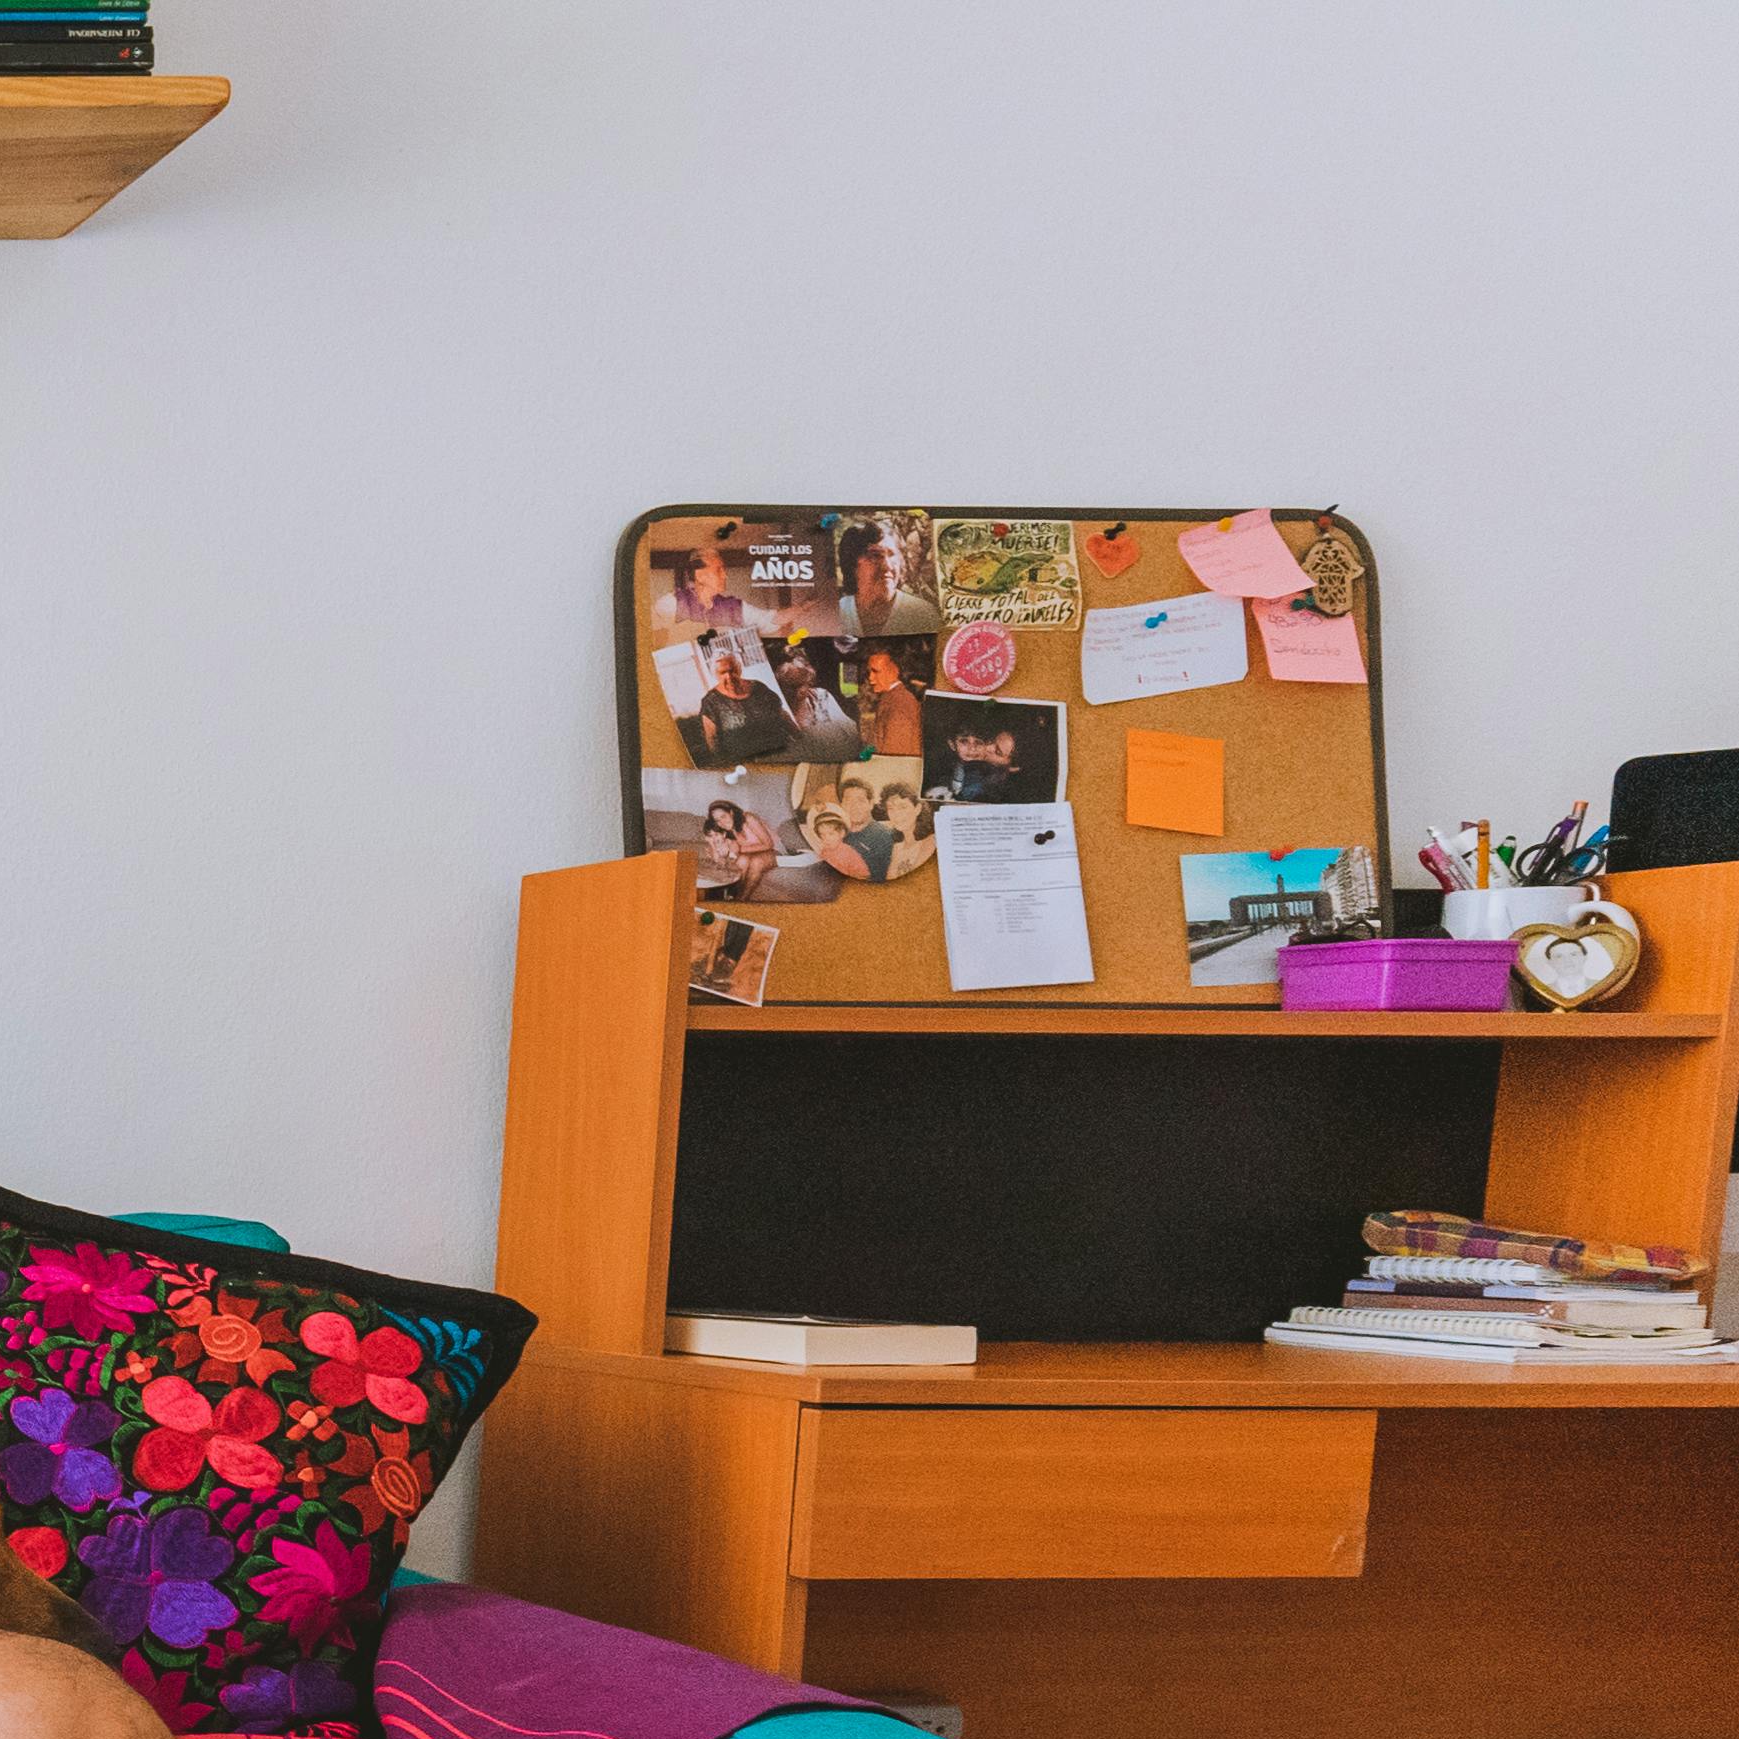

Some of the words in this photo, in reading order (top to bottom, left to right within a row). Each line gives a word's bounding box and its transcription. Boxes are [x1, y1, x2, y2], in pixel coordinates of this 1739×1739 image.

[68, 29, 123, 37] INTERNATIONAL
[749, 545, 789, 555] CUIDAR
[792, 545, 813, 555] LOS
[751, 556, 814, 580] AÑOS
[990, 590, 1031, 608] TOTAL
